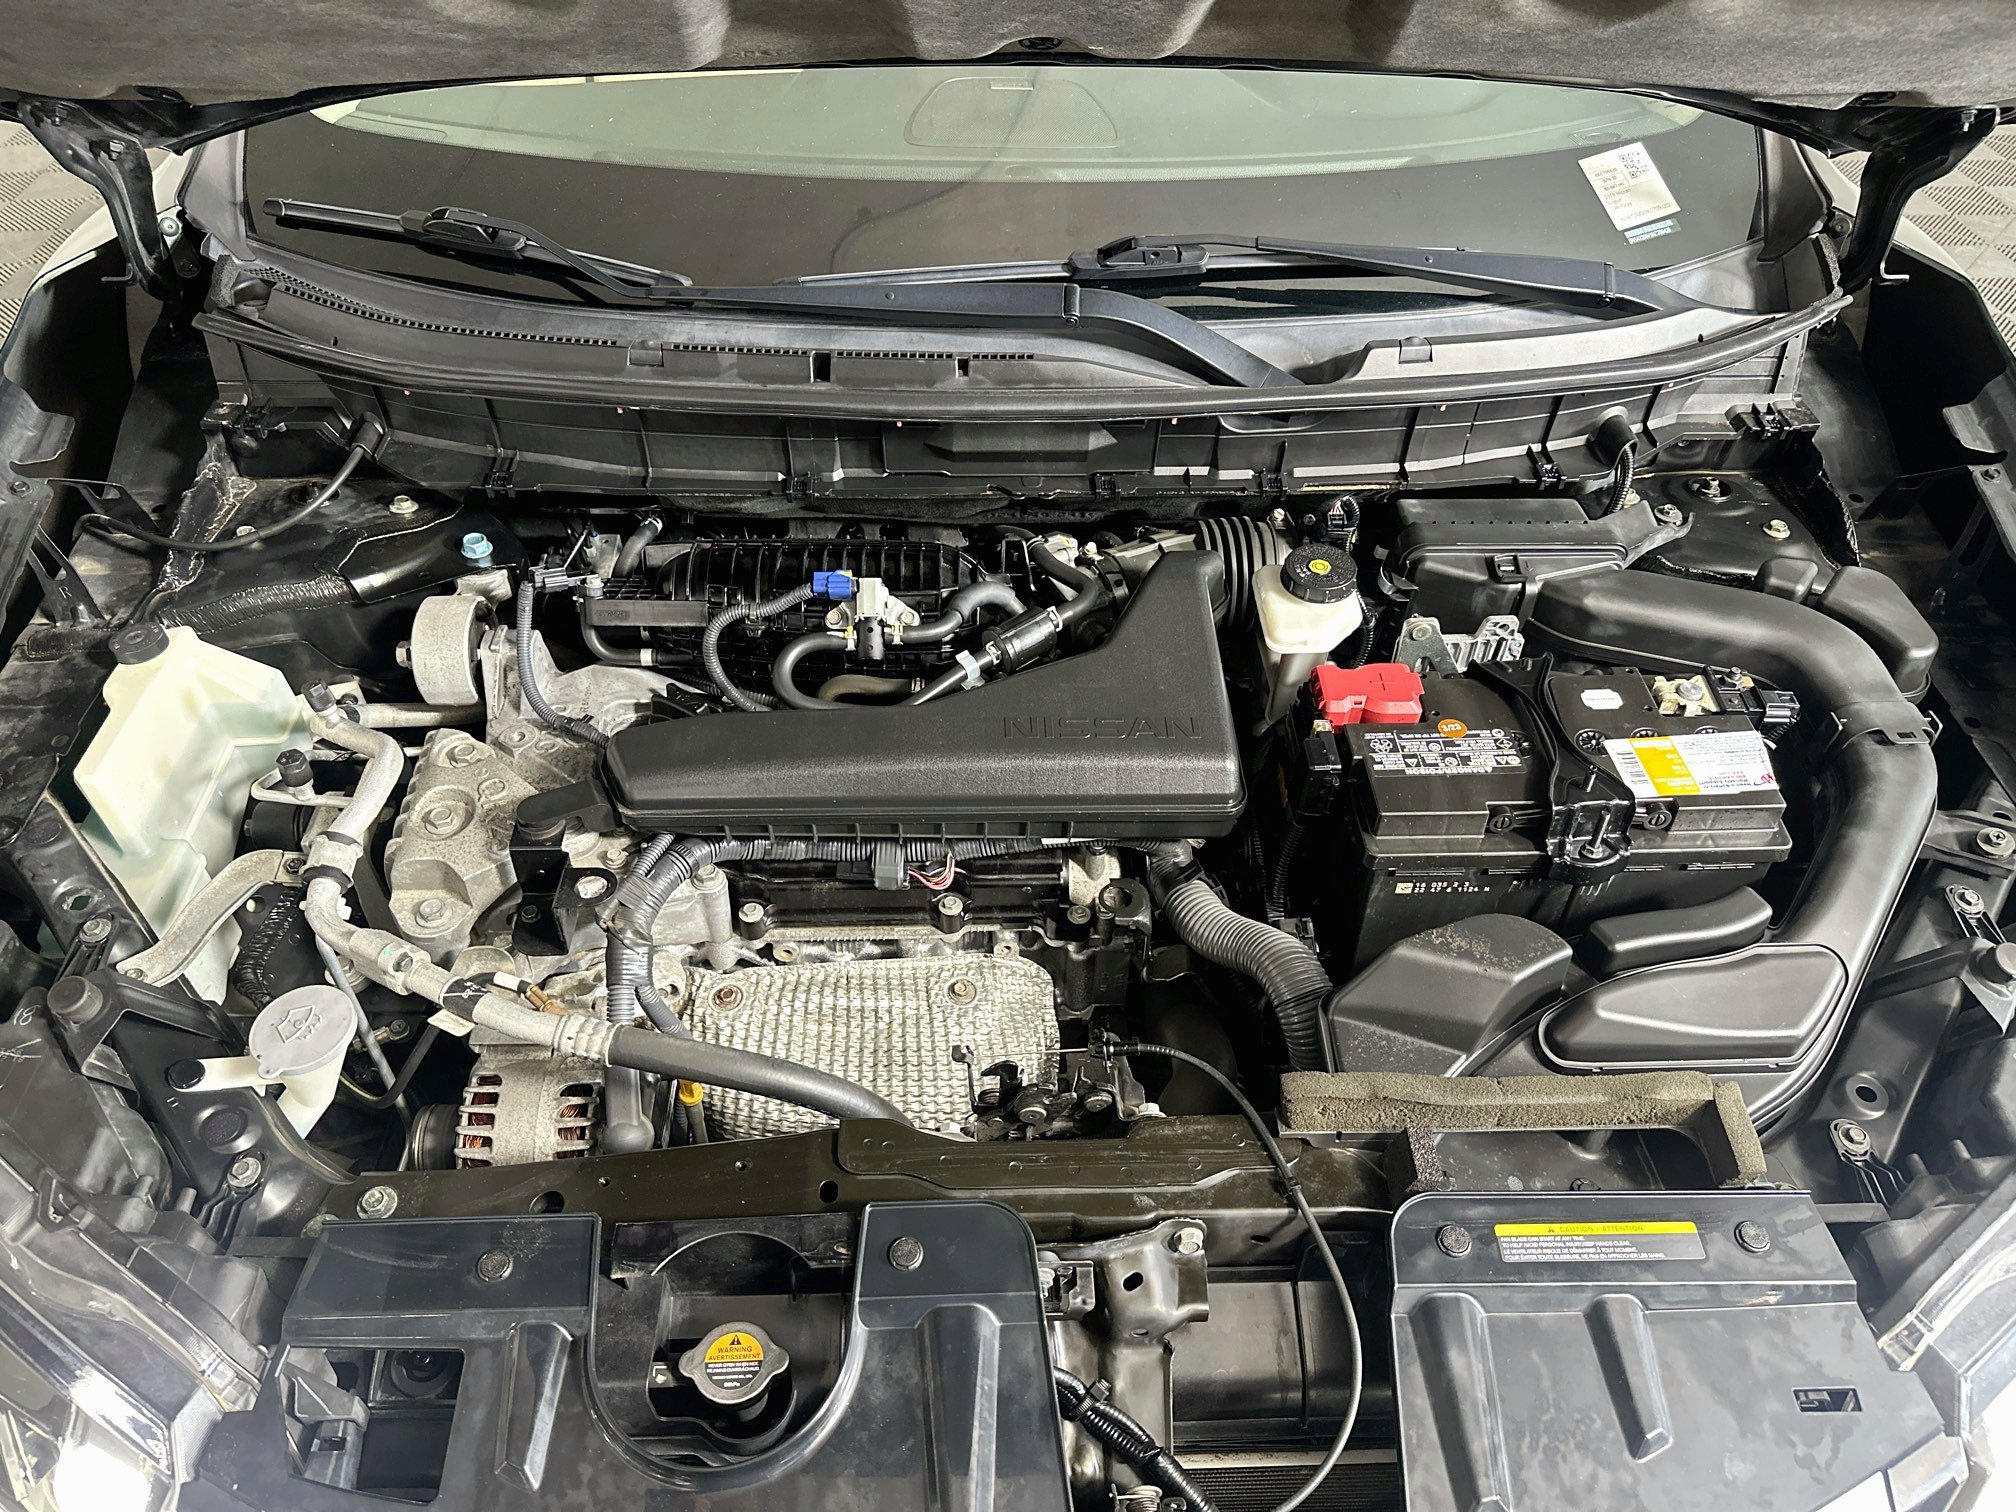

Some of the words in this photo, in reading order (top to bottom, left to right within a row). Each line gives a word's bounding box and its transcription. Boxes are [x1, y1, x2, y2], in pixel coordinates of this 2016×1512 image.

[1003, 716, 1202, 739] NISSAN
[1441, 722, 1462, 732] 3/23
[1405, 766, 1486, 774] DANGER/POISON
